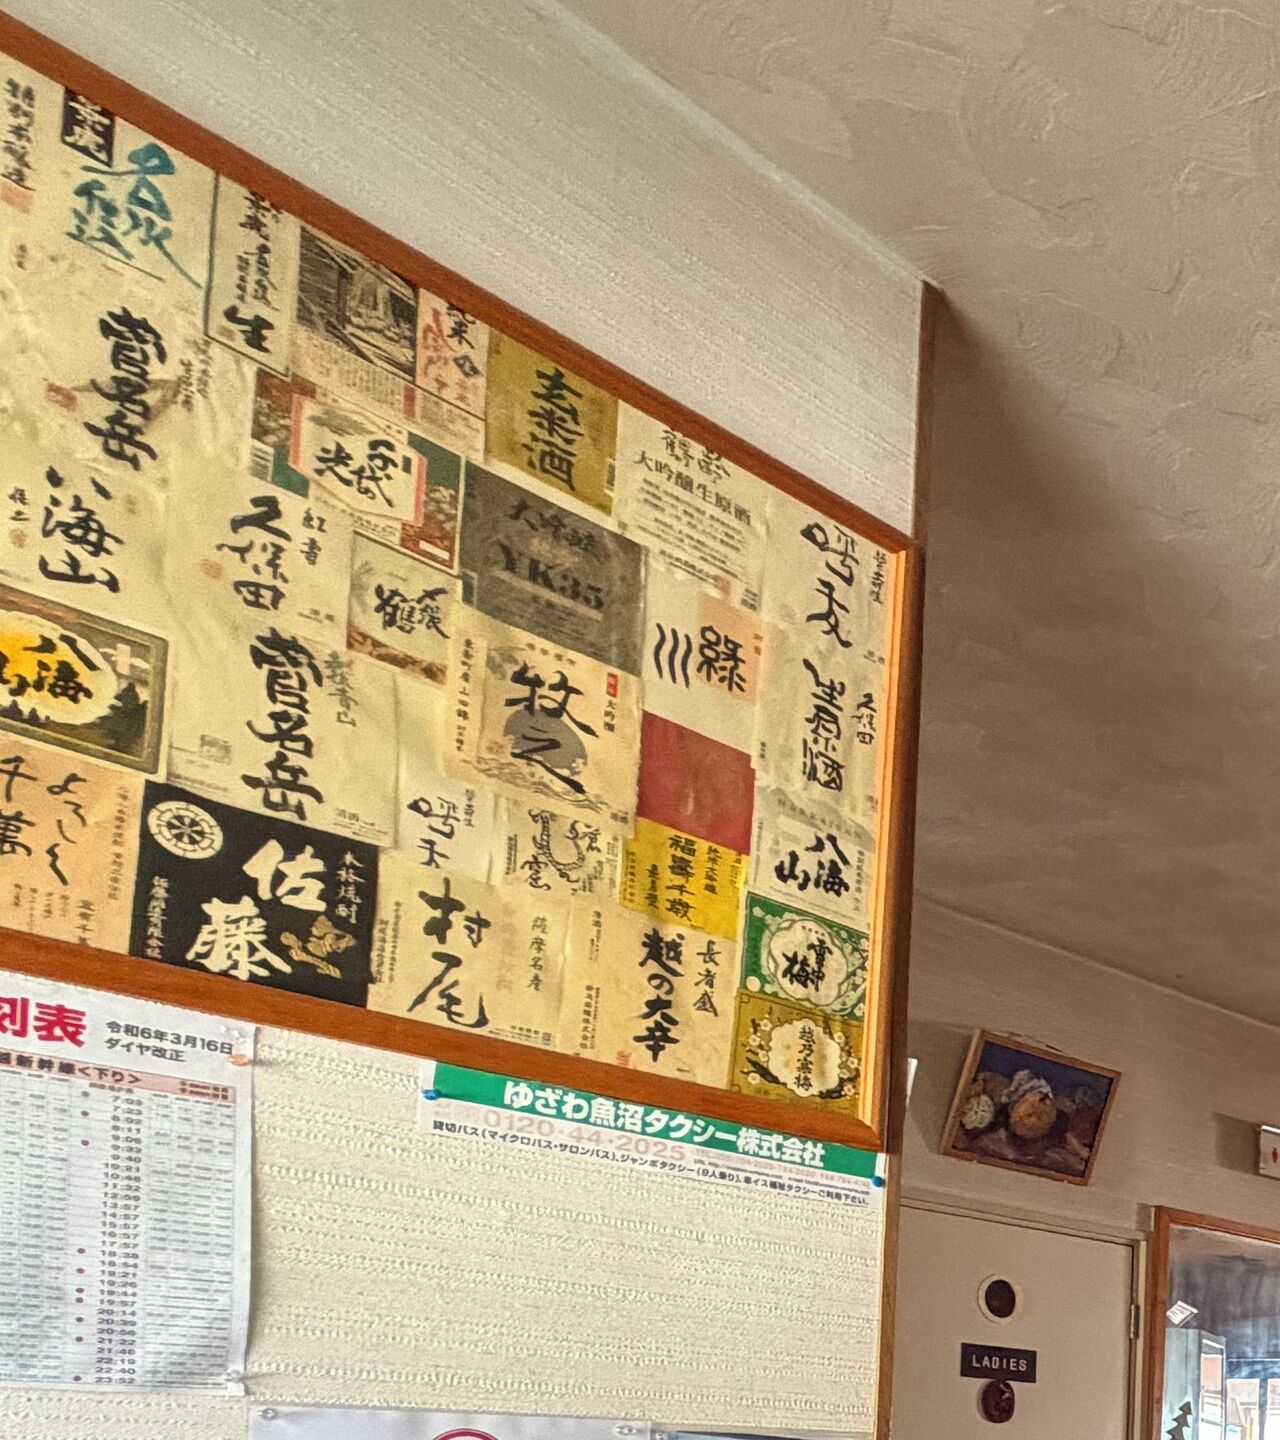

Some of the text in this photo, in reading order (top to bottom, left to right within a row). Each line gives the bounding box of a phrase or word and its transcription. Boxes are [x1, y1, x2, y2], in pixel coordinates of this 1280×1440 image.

[407, 877, 492, 1030] 村尾
[105, 1020, 234, 1056] 令和6年3月16日
[105, 1038, 186, 1063] ダイヤ改正
[503, 1080, 826, 1169] ゆざわ魚沼タクシー株式会社
[972, 1353, 1027, 1372] LADIES
